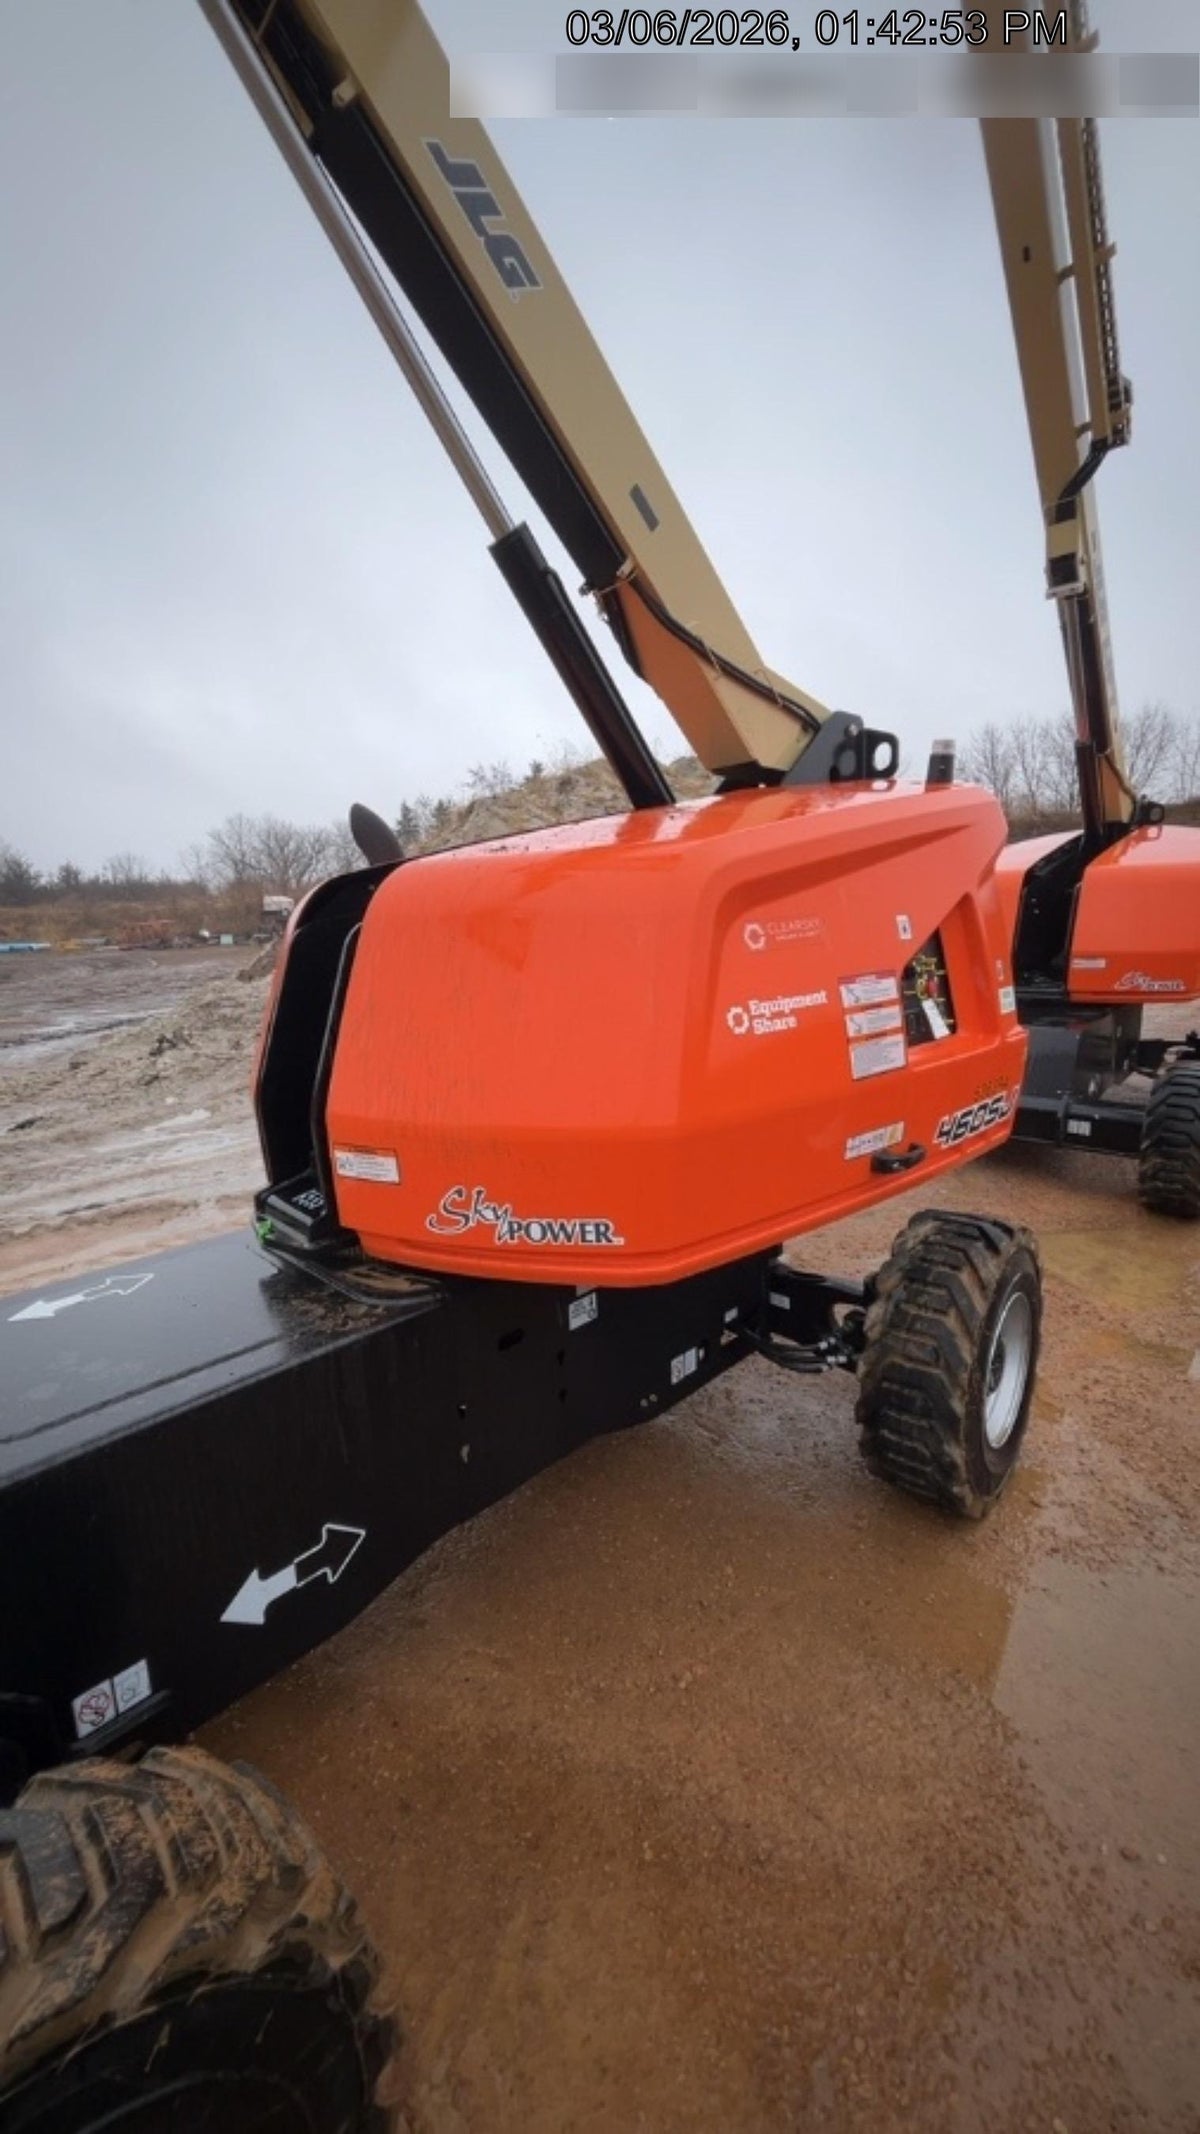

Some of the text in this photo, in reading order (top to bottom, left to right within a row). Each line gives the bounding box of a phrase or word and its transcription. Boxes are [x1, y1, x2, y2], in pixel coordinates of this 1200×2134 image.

[422, 137, 544, 290] JLG
[749, 990, 828, 1017] Equipment
[752, 1015, 798, 1034] Share
